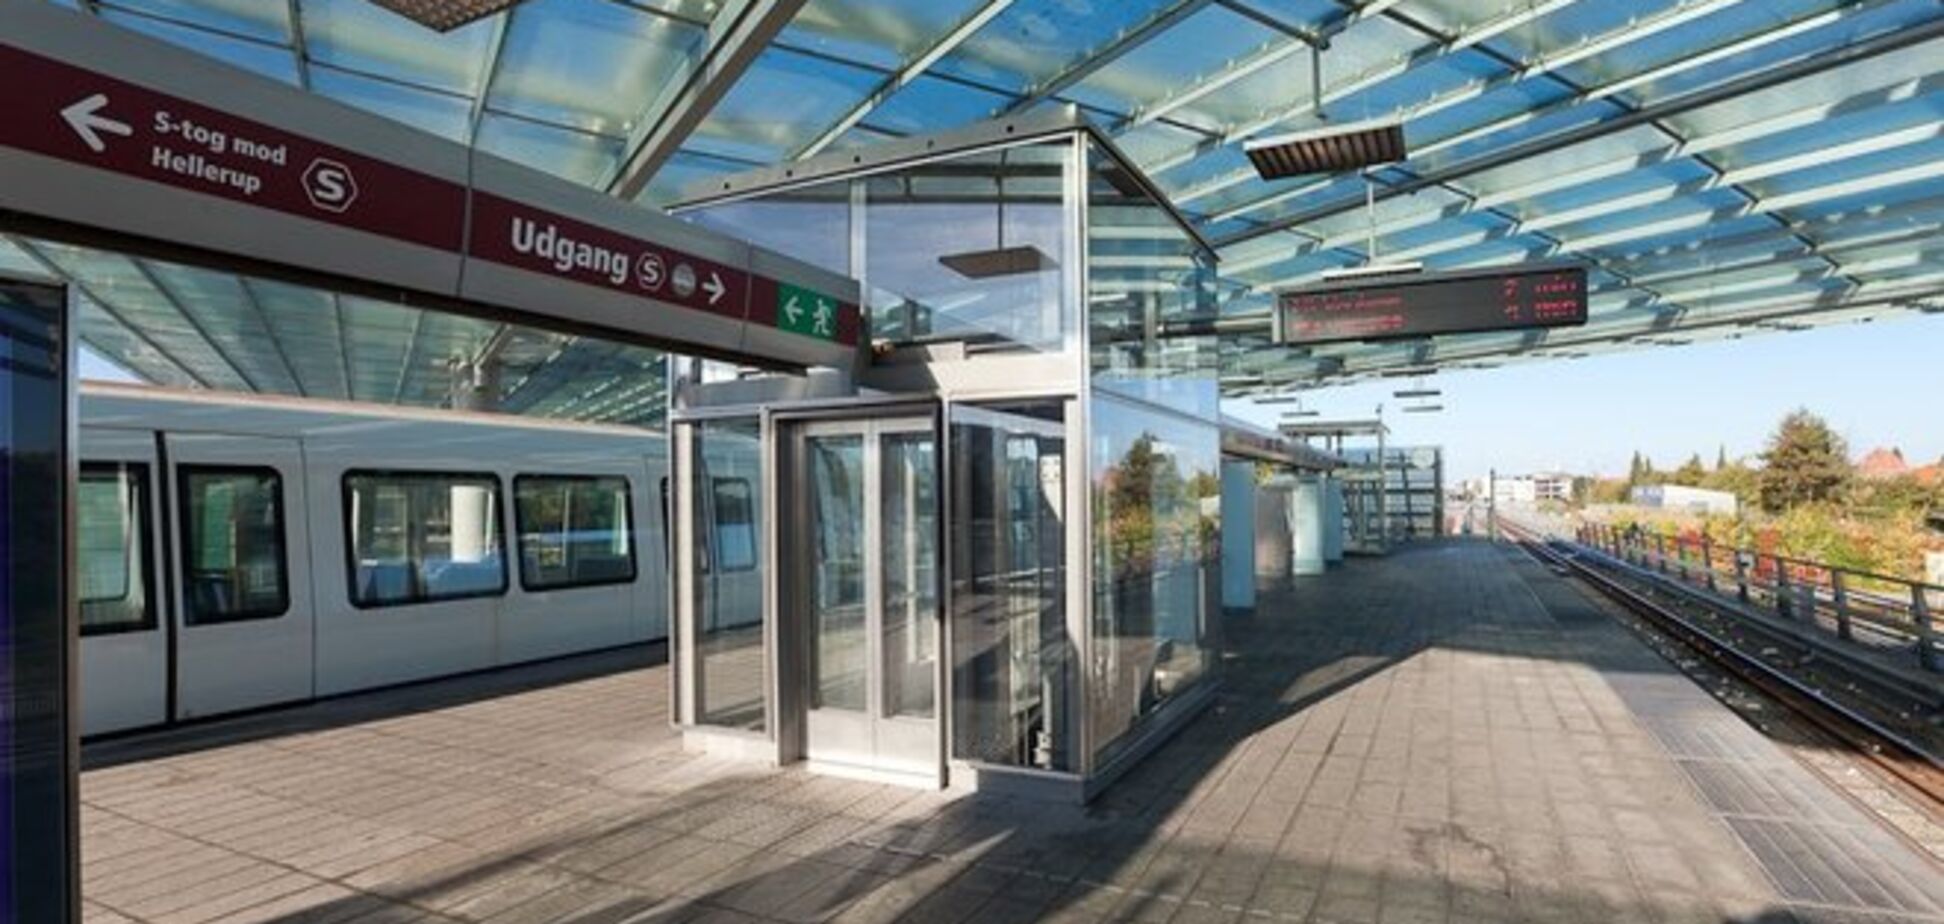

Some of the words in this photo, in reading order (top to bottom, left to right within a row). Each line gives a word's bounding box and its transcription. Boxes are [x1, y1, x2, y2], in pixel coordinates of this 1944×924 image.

[154, 111, 226, 152] S-tog
[233, 137, 286, 165] mod
[152, 146, 260, 194] Hellerup
[315, 168, 345, 201] S
[511, 217, 628, 284] Udgang
[642, 260, 659, 283] S
